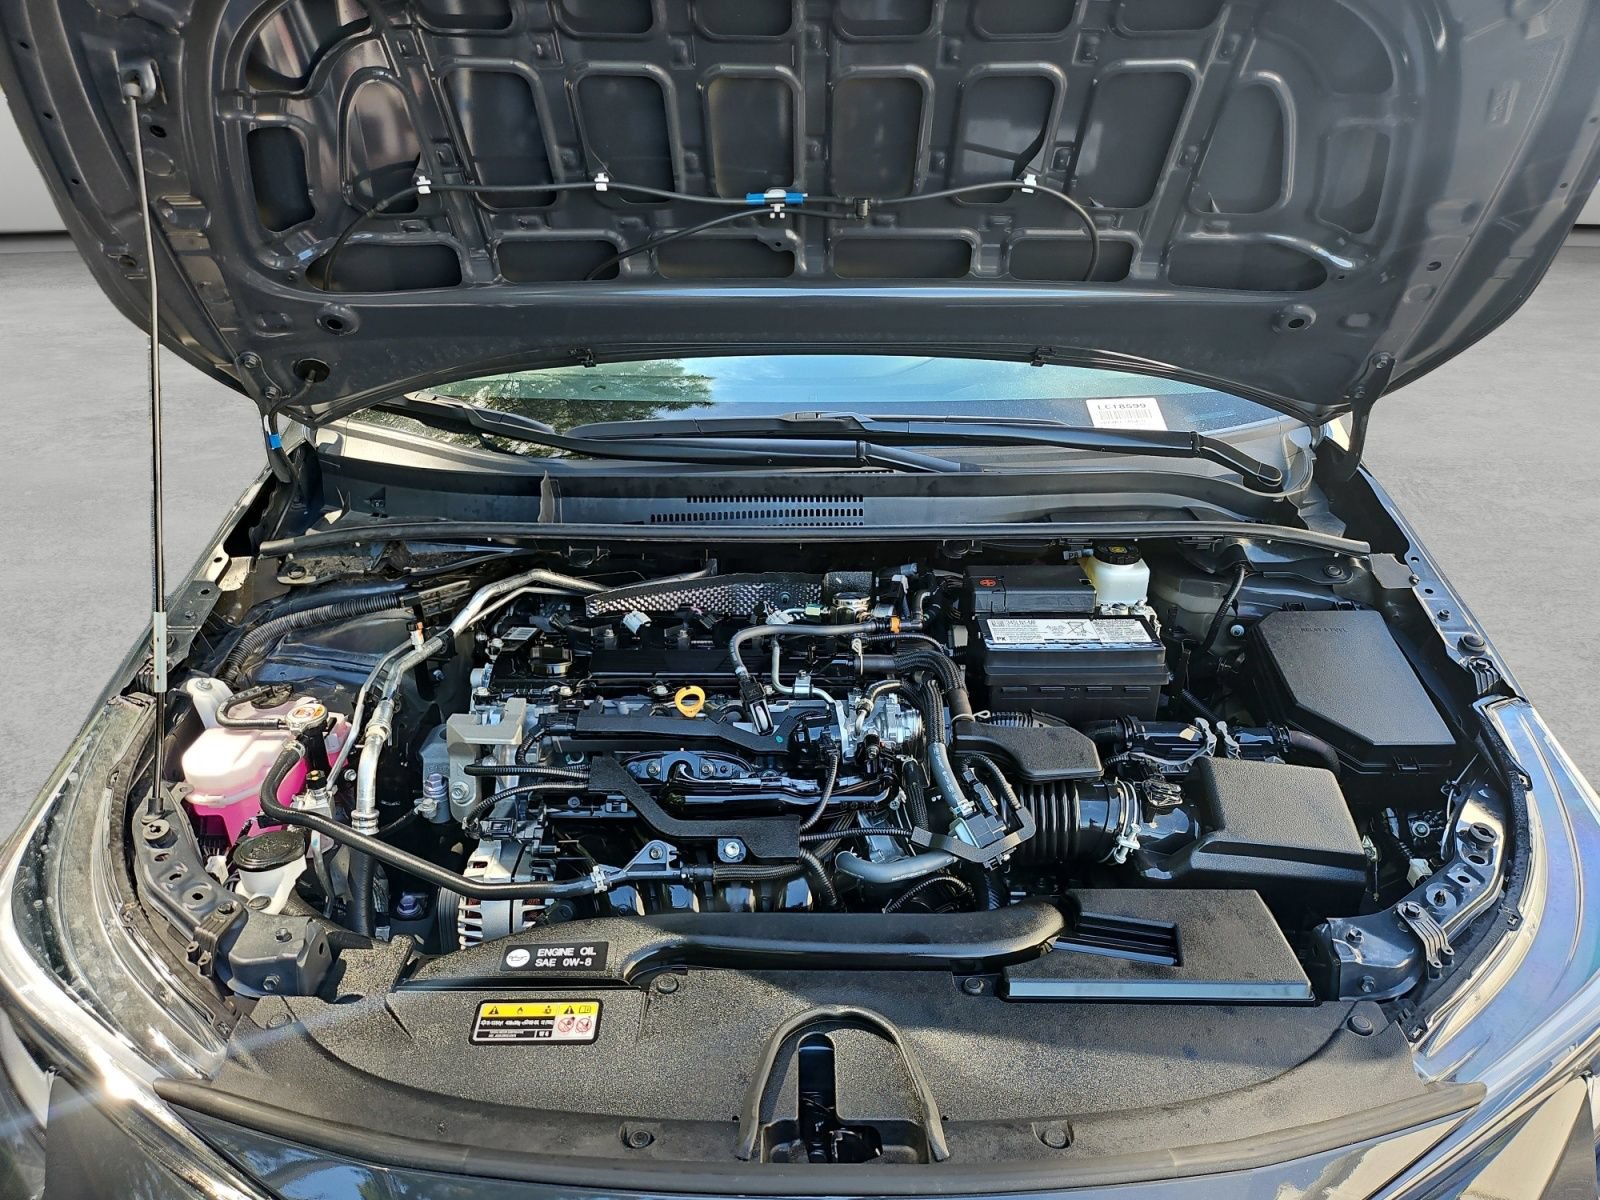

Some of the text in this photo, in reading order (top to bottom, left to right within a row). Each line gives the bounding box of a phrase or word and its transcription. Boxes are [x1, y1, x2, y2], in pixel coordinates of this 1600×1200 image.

[537, 946, 597, 957] ENGINE OIL
[535, 957, 592, 967] SAE 0W-8
